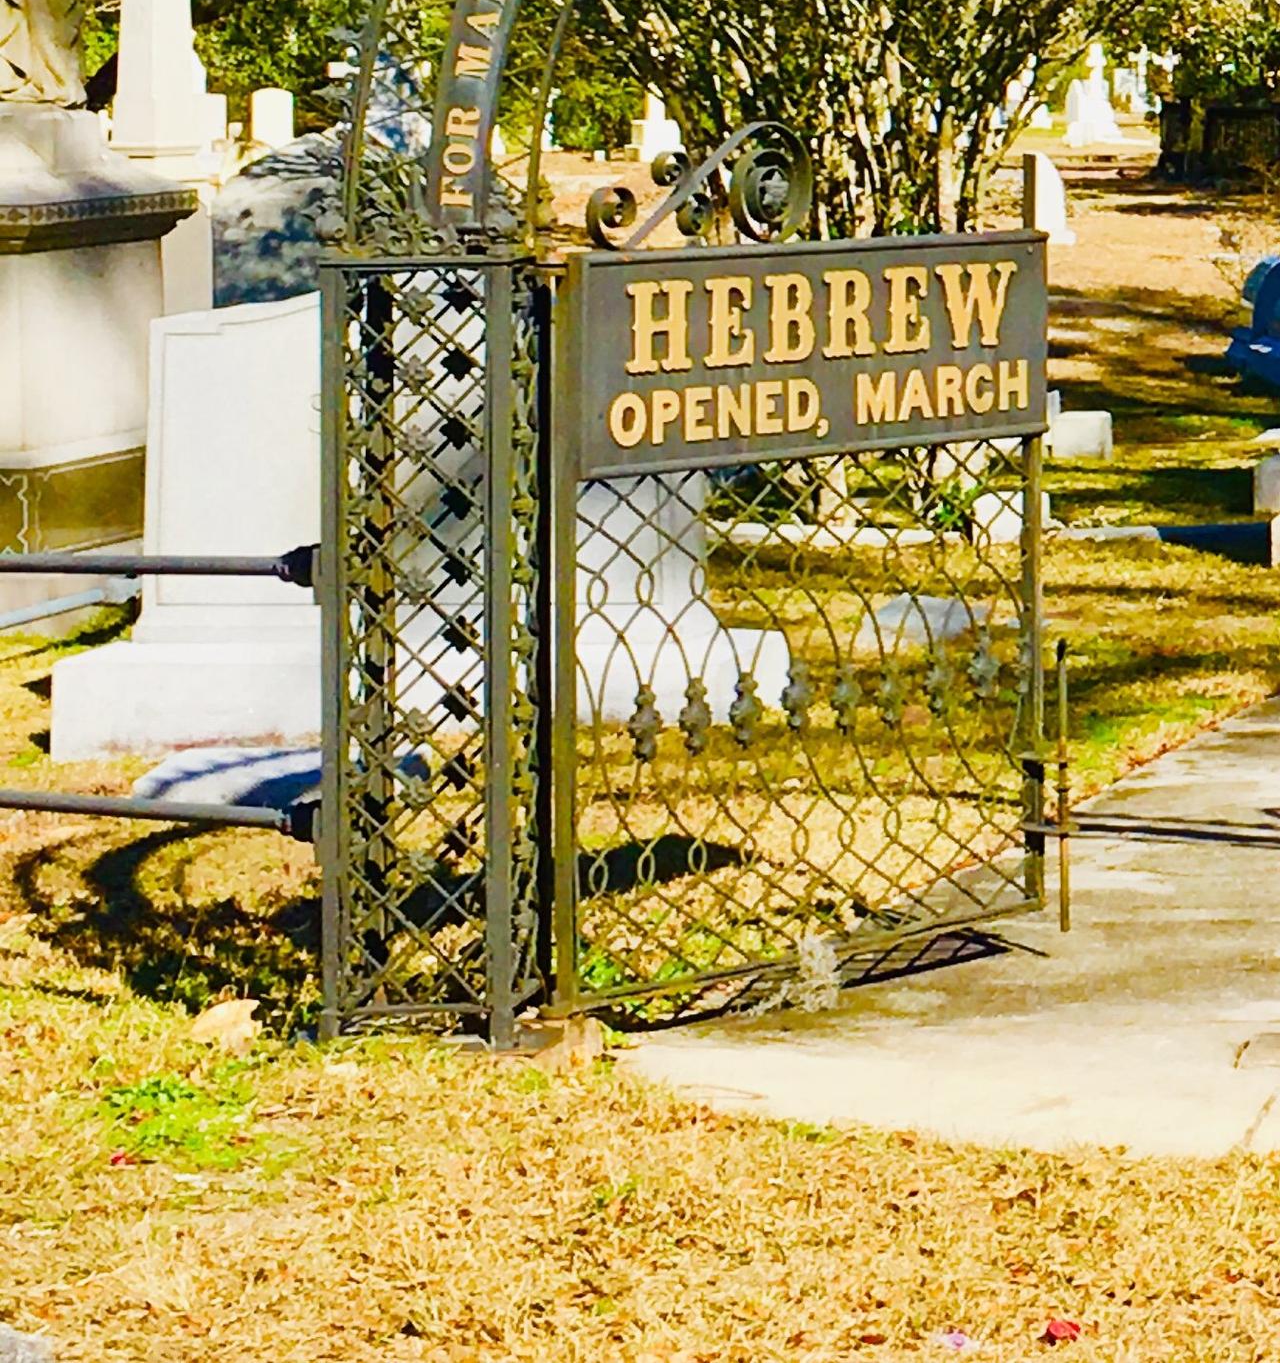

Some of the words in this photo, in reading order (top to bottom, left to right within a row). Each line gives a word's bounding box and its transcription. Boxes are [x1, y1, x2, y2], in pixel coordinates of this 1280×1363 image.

[441, 106, 482, 207] FOR
[625, 261, 1018, 375] HEBREW
[609, 377, 829, 448] OPENED,
[855, 359, 1029, 426] MARCH
